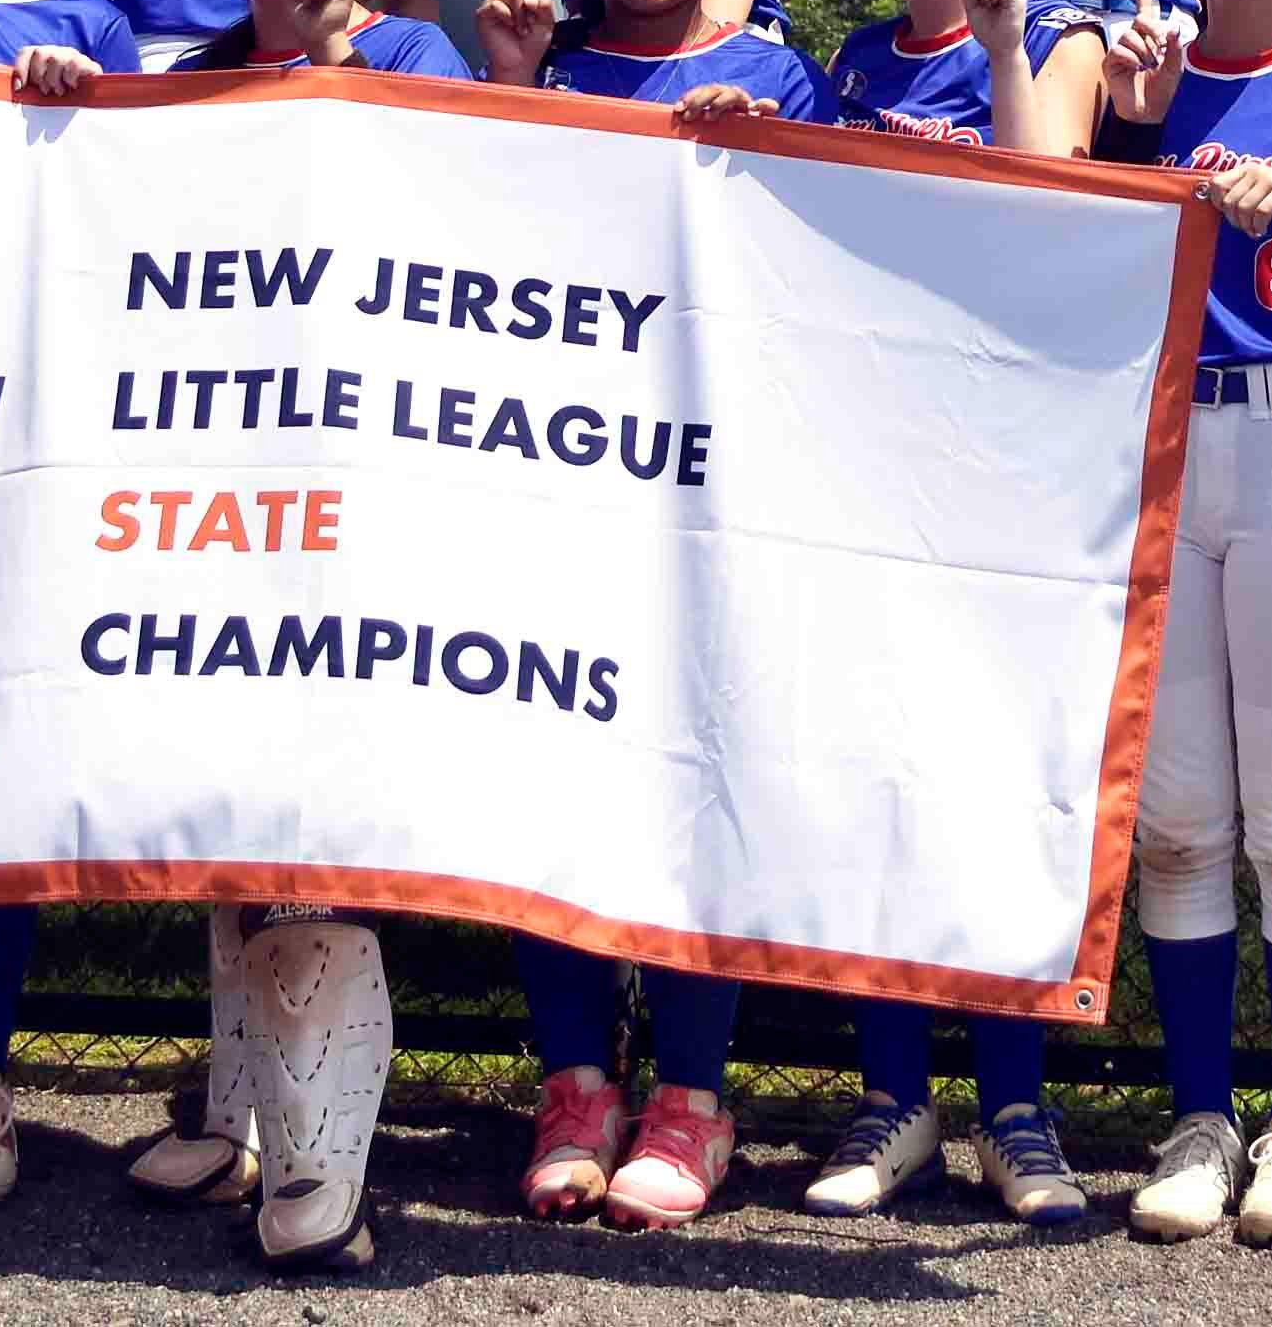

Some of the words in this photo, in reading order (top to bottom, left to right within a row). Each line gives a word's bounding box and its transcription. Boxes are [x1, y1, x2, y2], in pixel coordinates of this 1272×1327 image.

[126, 247, 333, 310] NEW
[354, 257, 666, 353] JERSEY
[112, 367, 362, 430] LITTLE
[392, 380, 714, 487] LEAGUE
[95, 490, 344, 553] STATE
[80, 613, 620, 723] CHAMPIONS
